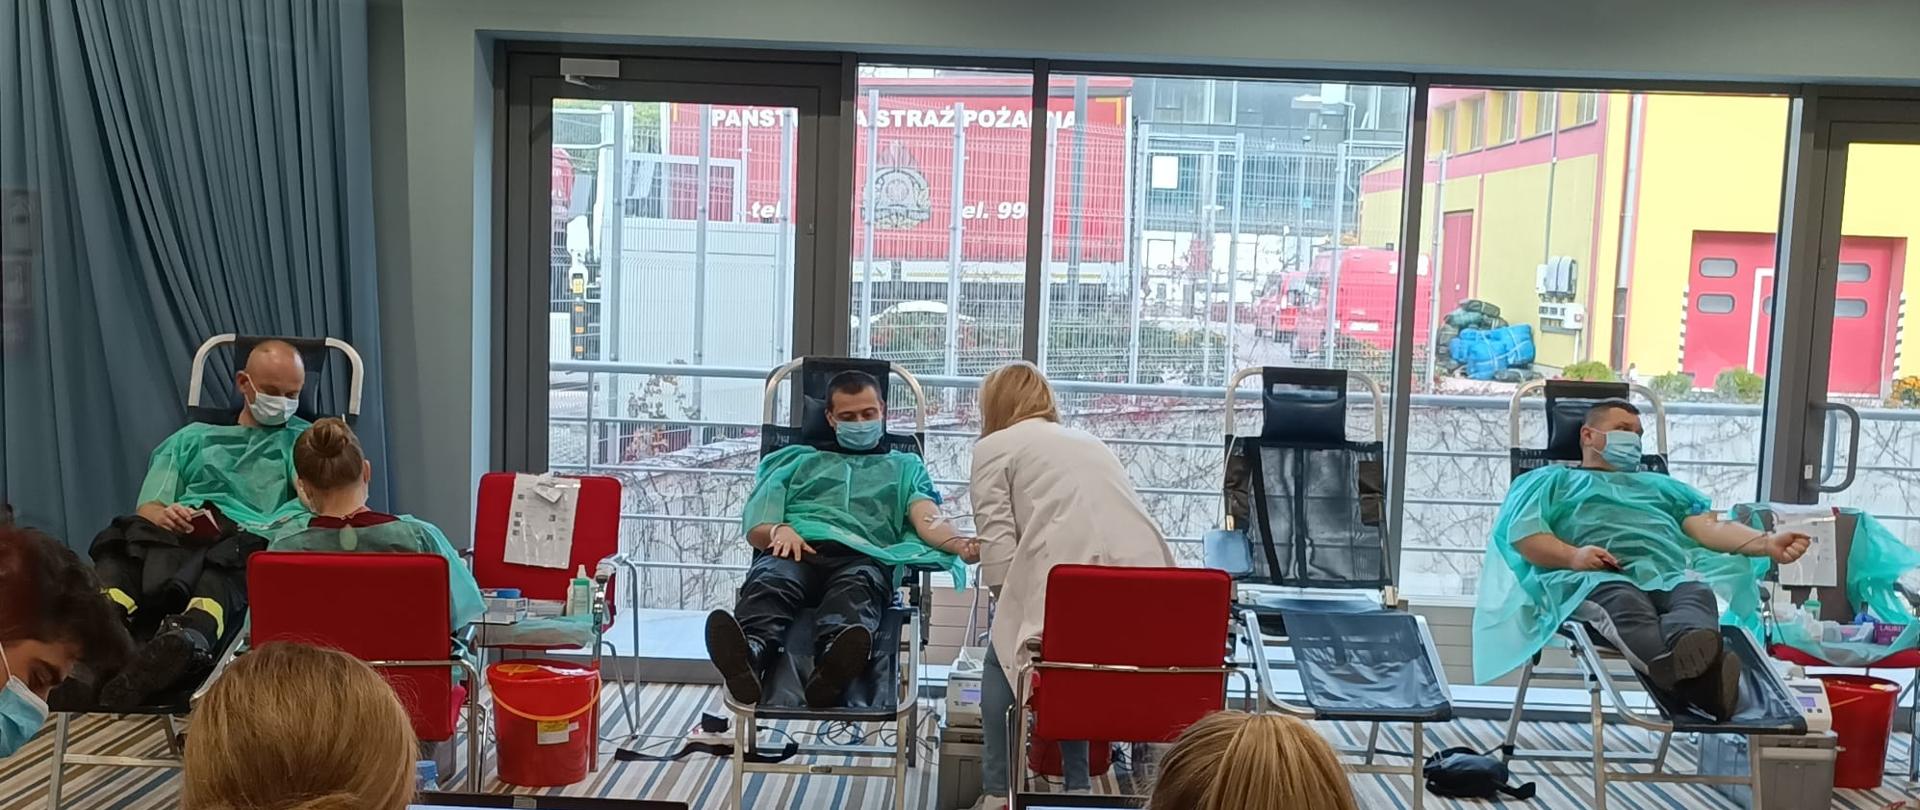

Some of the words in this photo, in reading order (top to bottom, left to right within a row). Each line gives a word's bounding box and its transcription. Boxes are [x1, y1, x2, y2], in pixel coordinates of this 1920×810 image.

[877, 106, 955, 128] STRAŻ
[962, 200, 989, 219] el.
[997, 201, 1026, 219] 99
